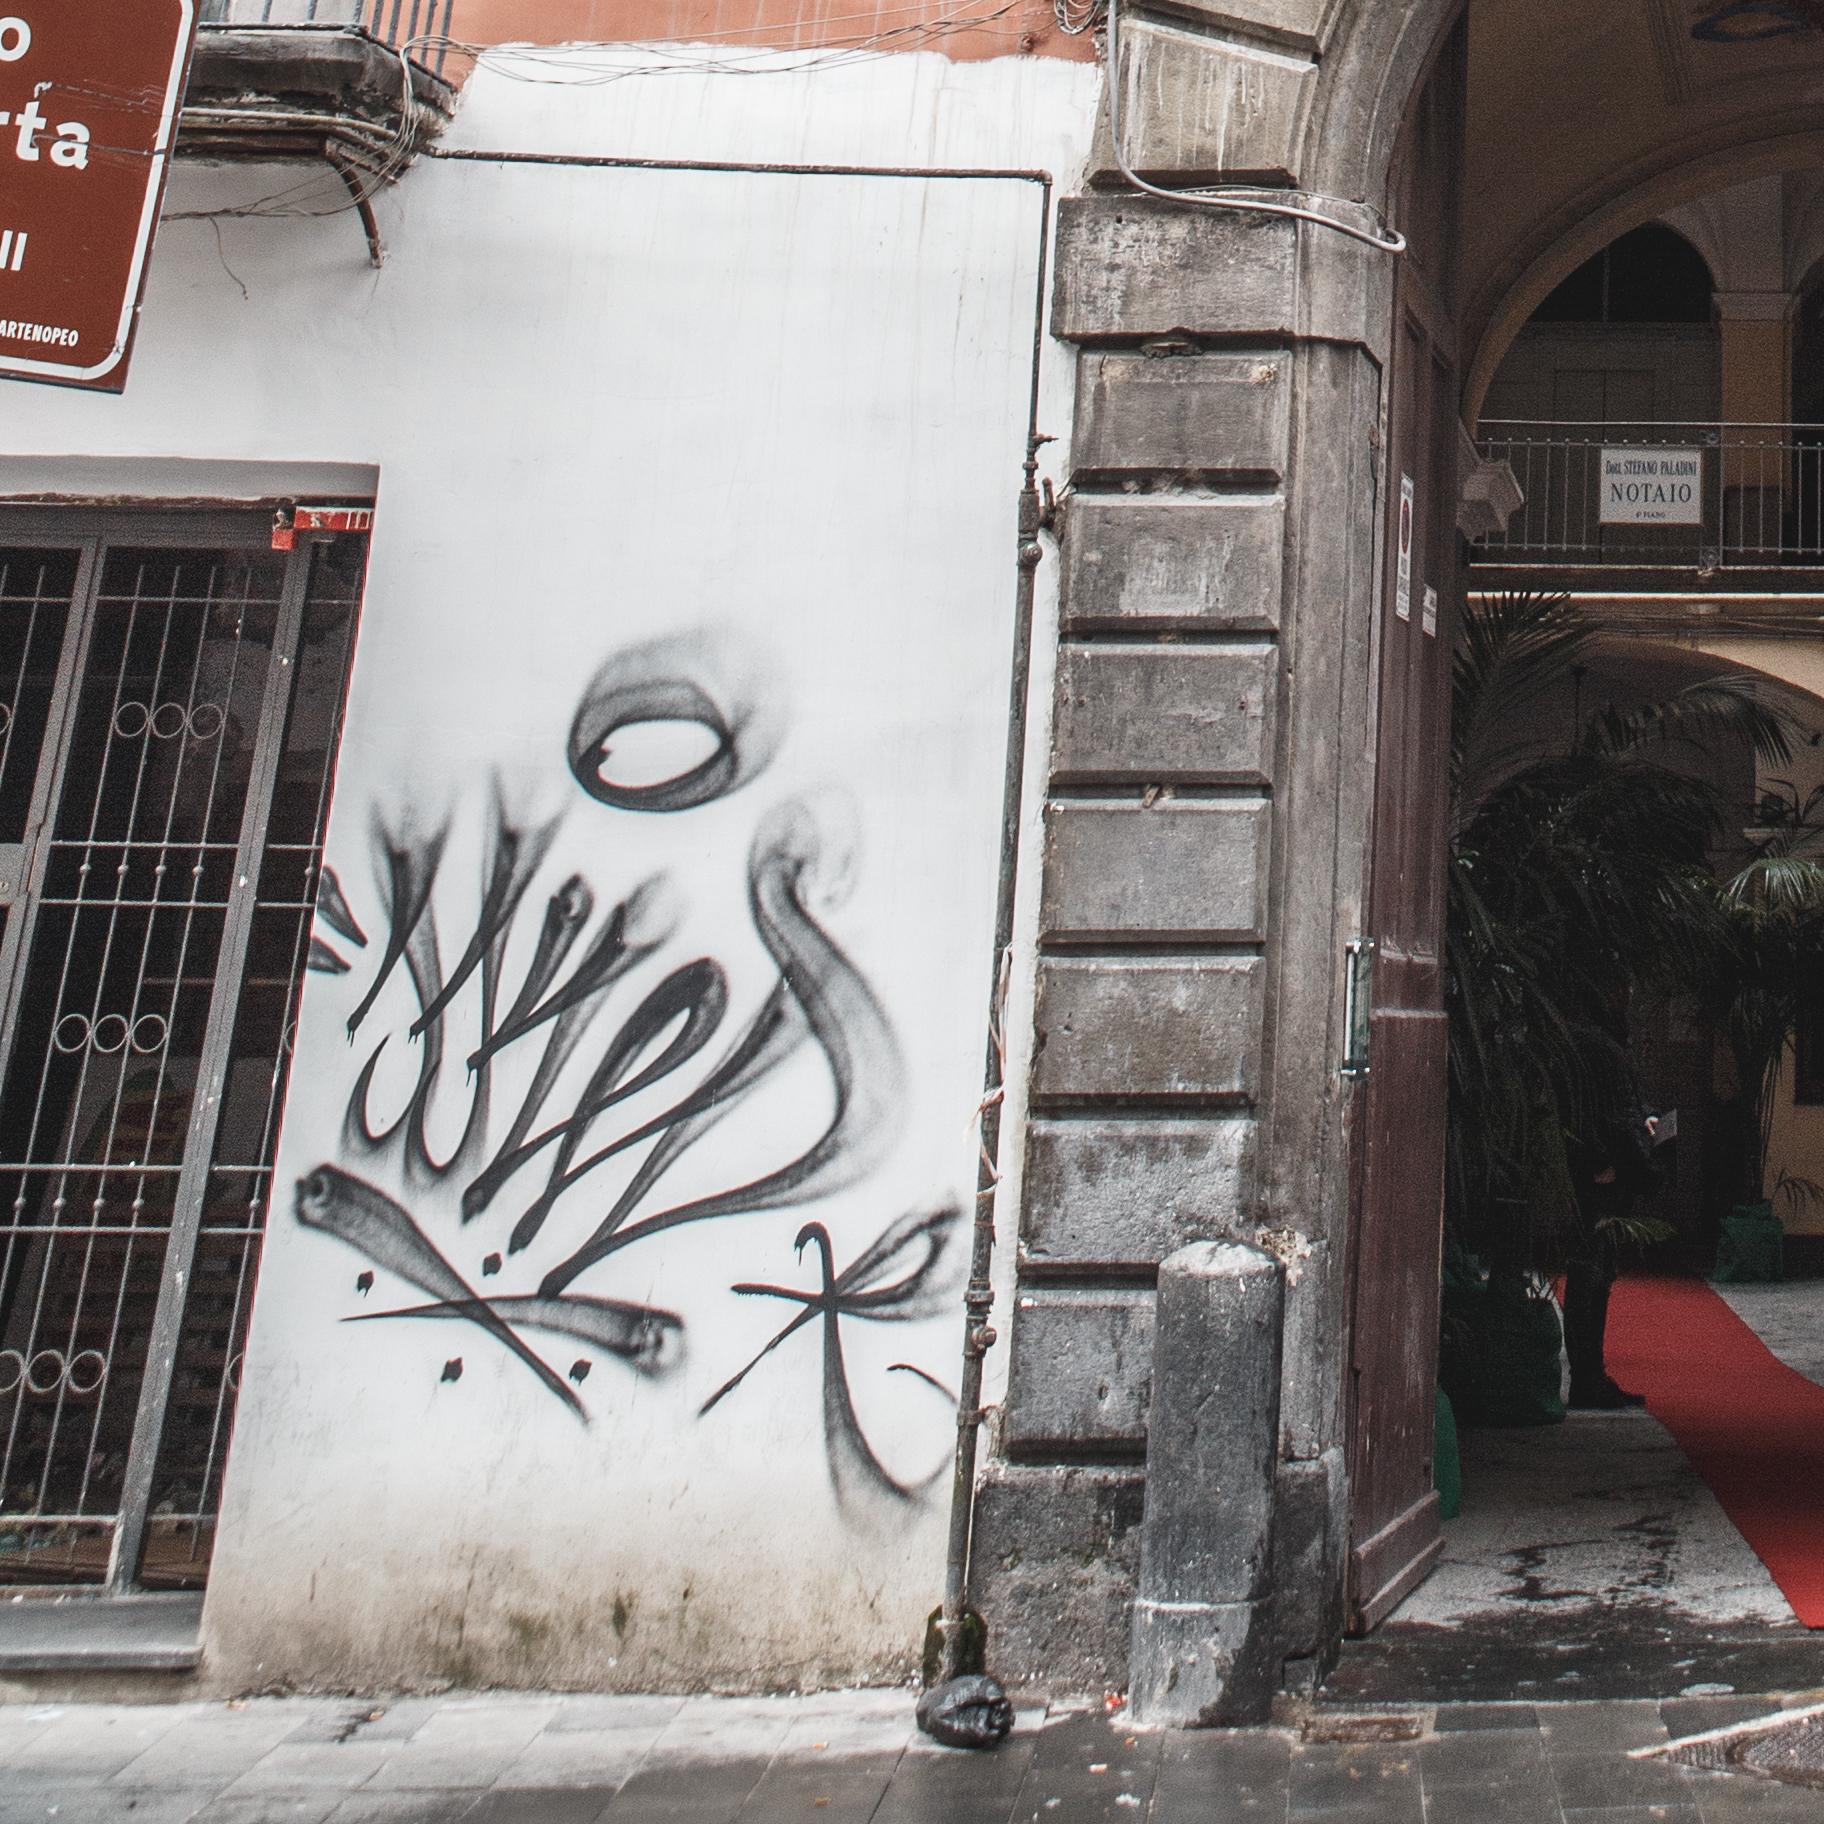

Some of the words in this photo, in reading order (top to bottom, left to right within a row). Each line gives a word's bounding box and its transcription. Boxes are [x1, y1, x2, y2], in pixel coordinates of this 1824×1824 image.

[1624, 460, 1658, 475] STEFANO
[1661, 460, 1697, 476] PALADINI
[1611, 482, 1692, 503] NOTAIO
